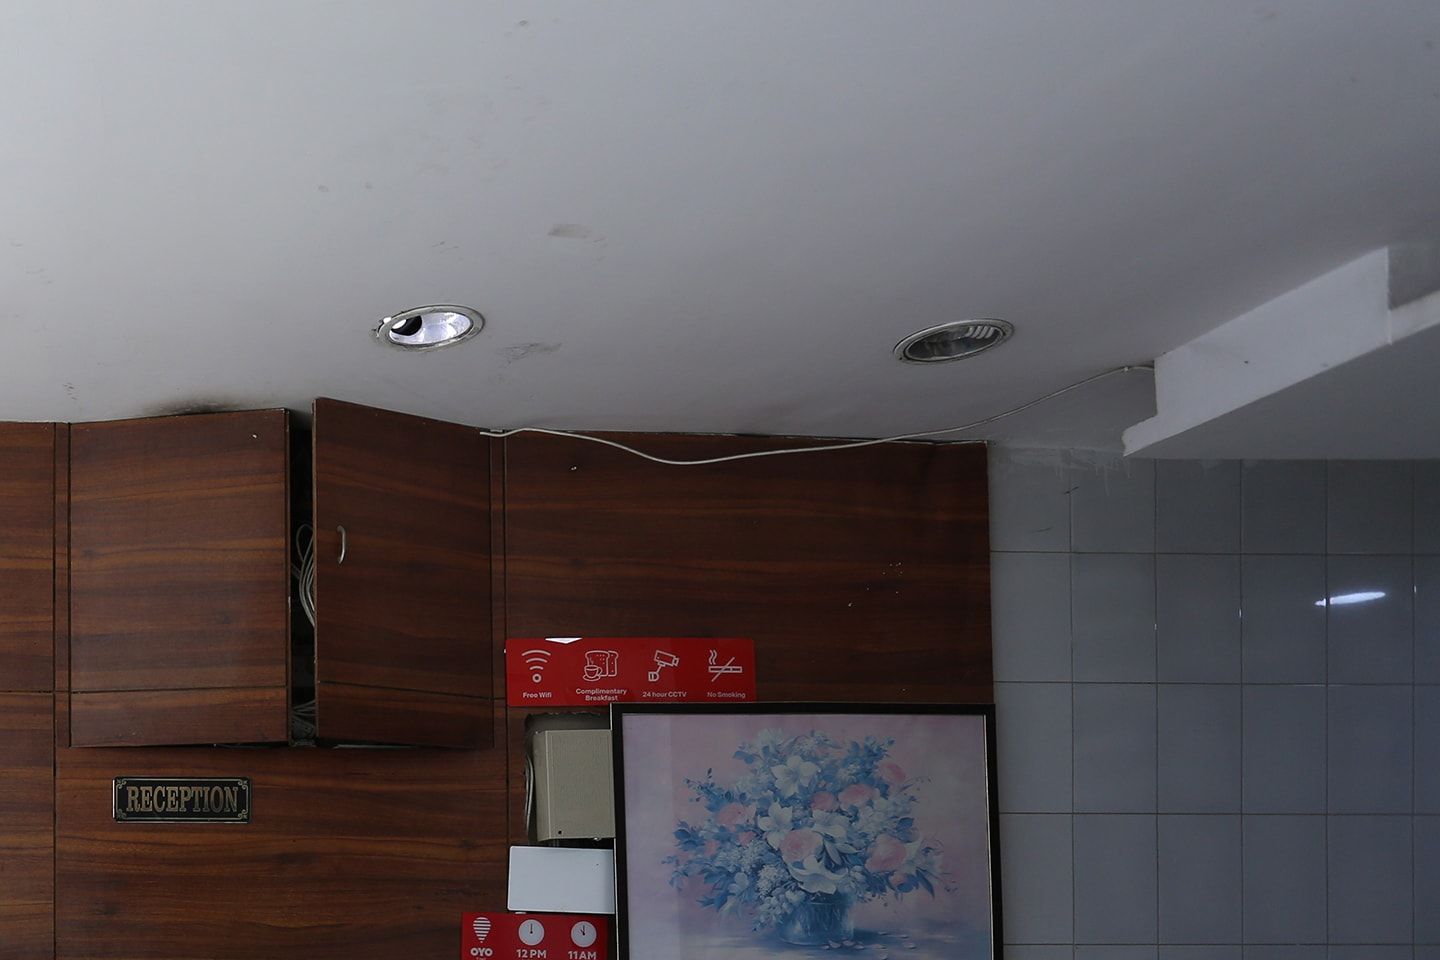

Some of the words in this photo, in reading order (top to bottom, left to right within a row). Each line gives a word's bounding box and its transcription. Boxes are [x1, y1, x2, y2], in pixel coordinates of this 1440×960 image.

[126, 786, 239, 813] RECEPTION
[470, 947, 493, 957] OYO
[516, 949, 528, 958] 12
[530, 949, 547, 959] PM
[568, 950, 578, 960] 11
[579, 951, 597, 960] AM
